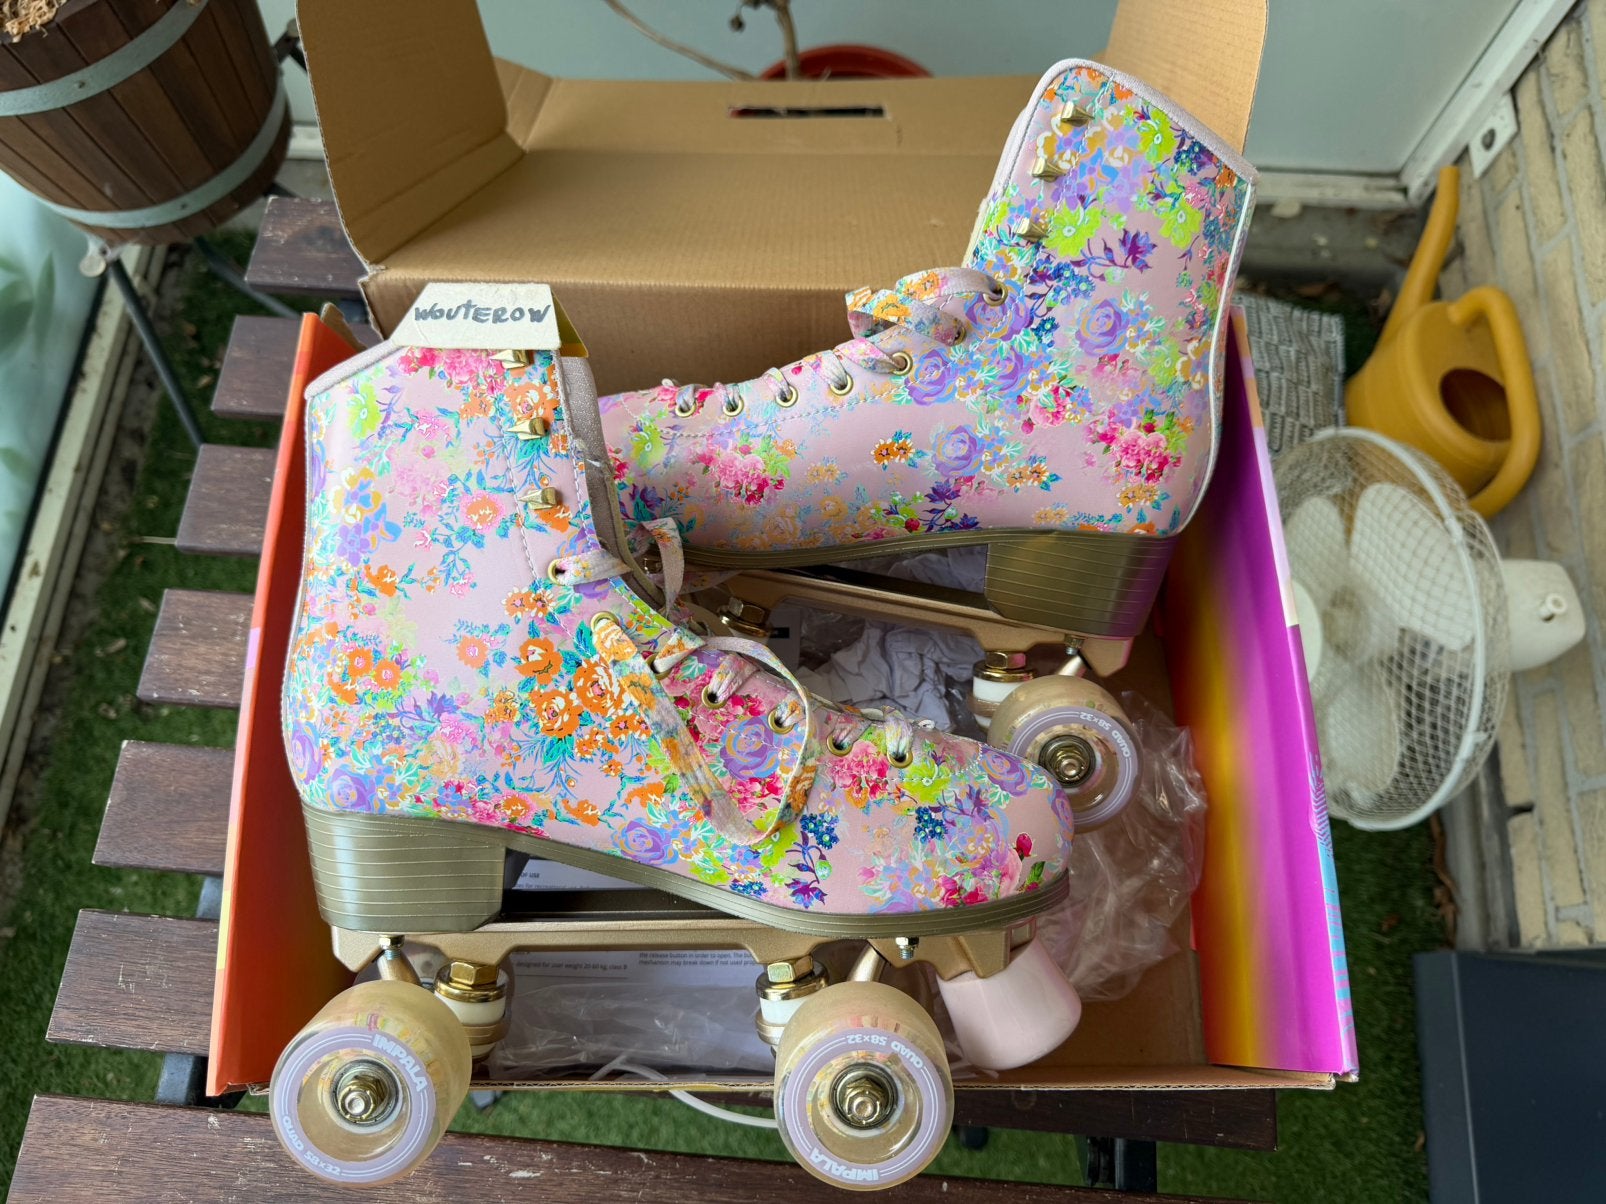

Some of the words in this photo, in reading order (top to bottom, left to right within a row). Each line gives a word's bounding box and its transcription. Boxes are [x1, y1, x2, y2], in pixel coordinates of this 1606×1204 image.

[1111, 730, 1131, 758] QUAD
[516, 961, 541, 969] designed
[371, 1033, 428, 1093] IMPALA
[891, 1040, 924, 1070] QUAD
[283, 1115, 305, 1151] QUAD
[808, 1147, 881, 1182] IMPALA
